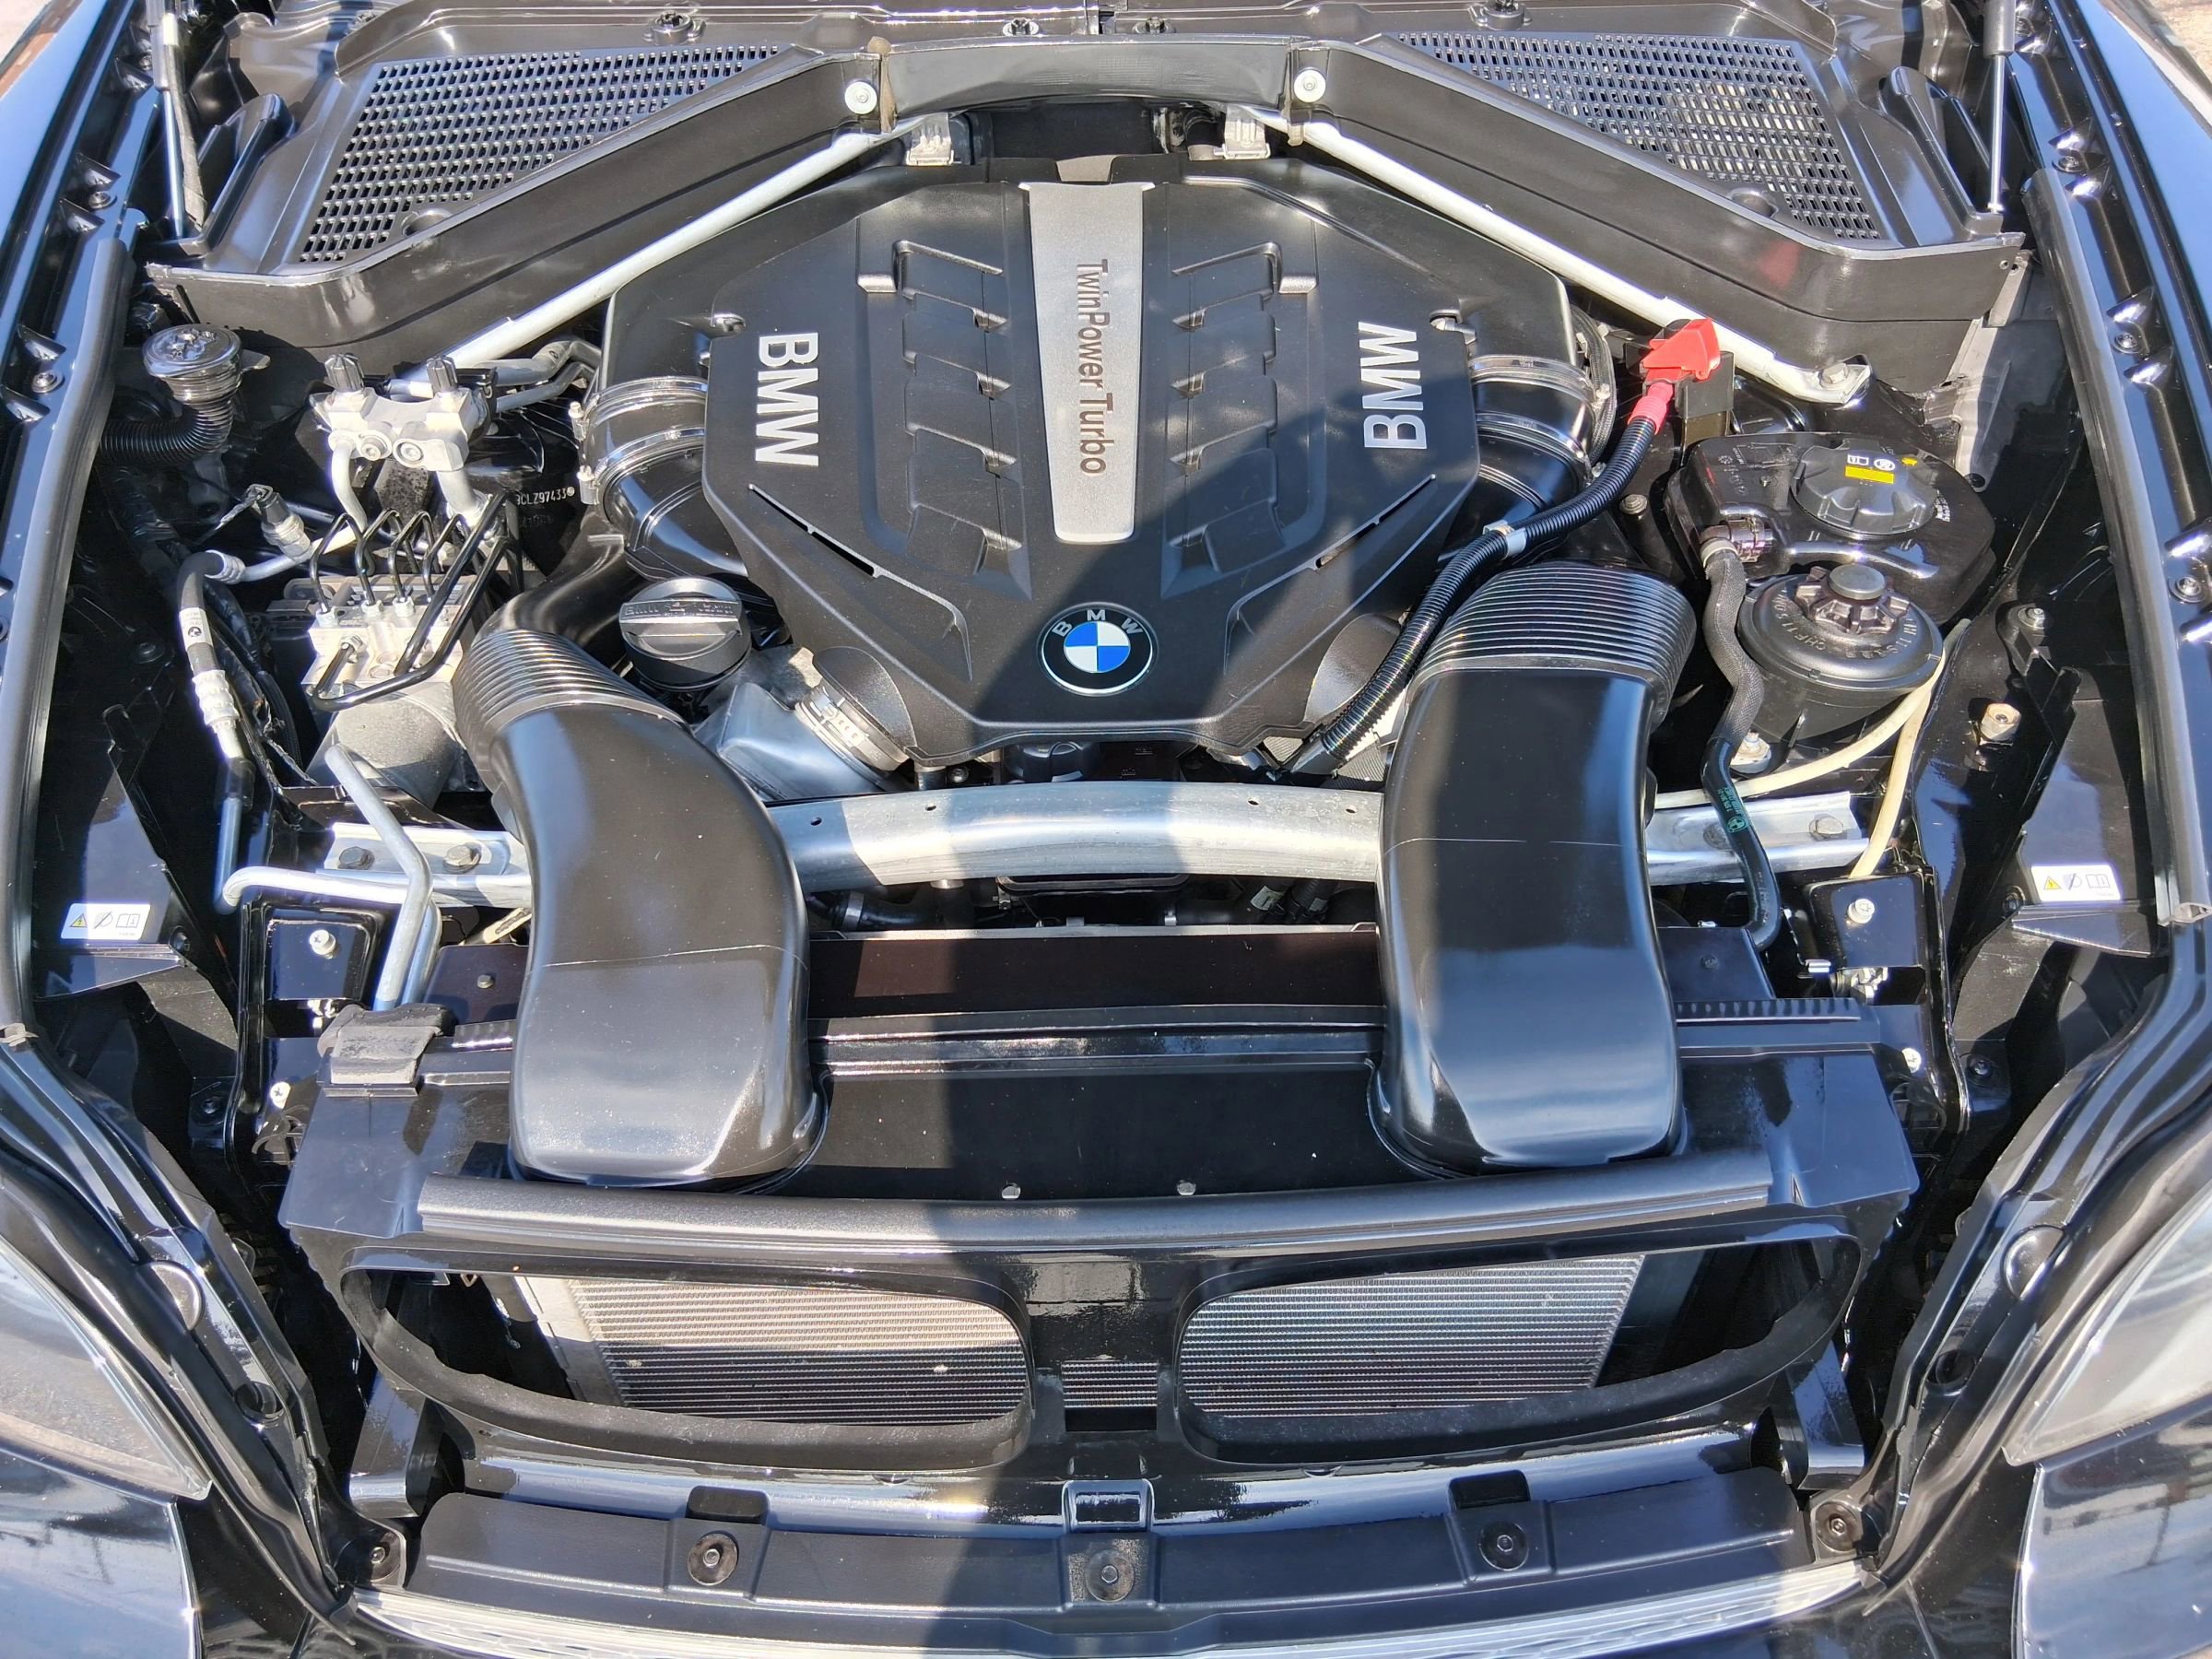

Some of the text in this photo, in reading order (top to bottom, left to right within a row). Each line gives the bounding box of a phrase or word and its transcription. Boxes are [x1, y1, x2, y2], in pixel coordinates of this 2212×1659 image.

[756, 333, 819, 466] BMW
[1077, 259, 1114, 474] TwinPower Turbo
[1359, 322, 1427, 449] BMW
[1052, 609, 1143, 637] BMW
